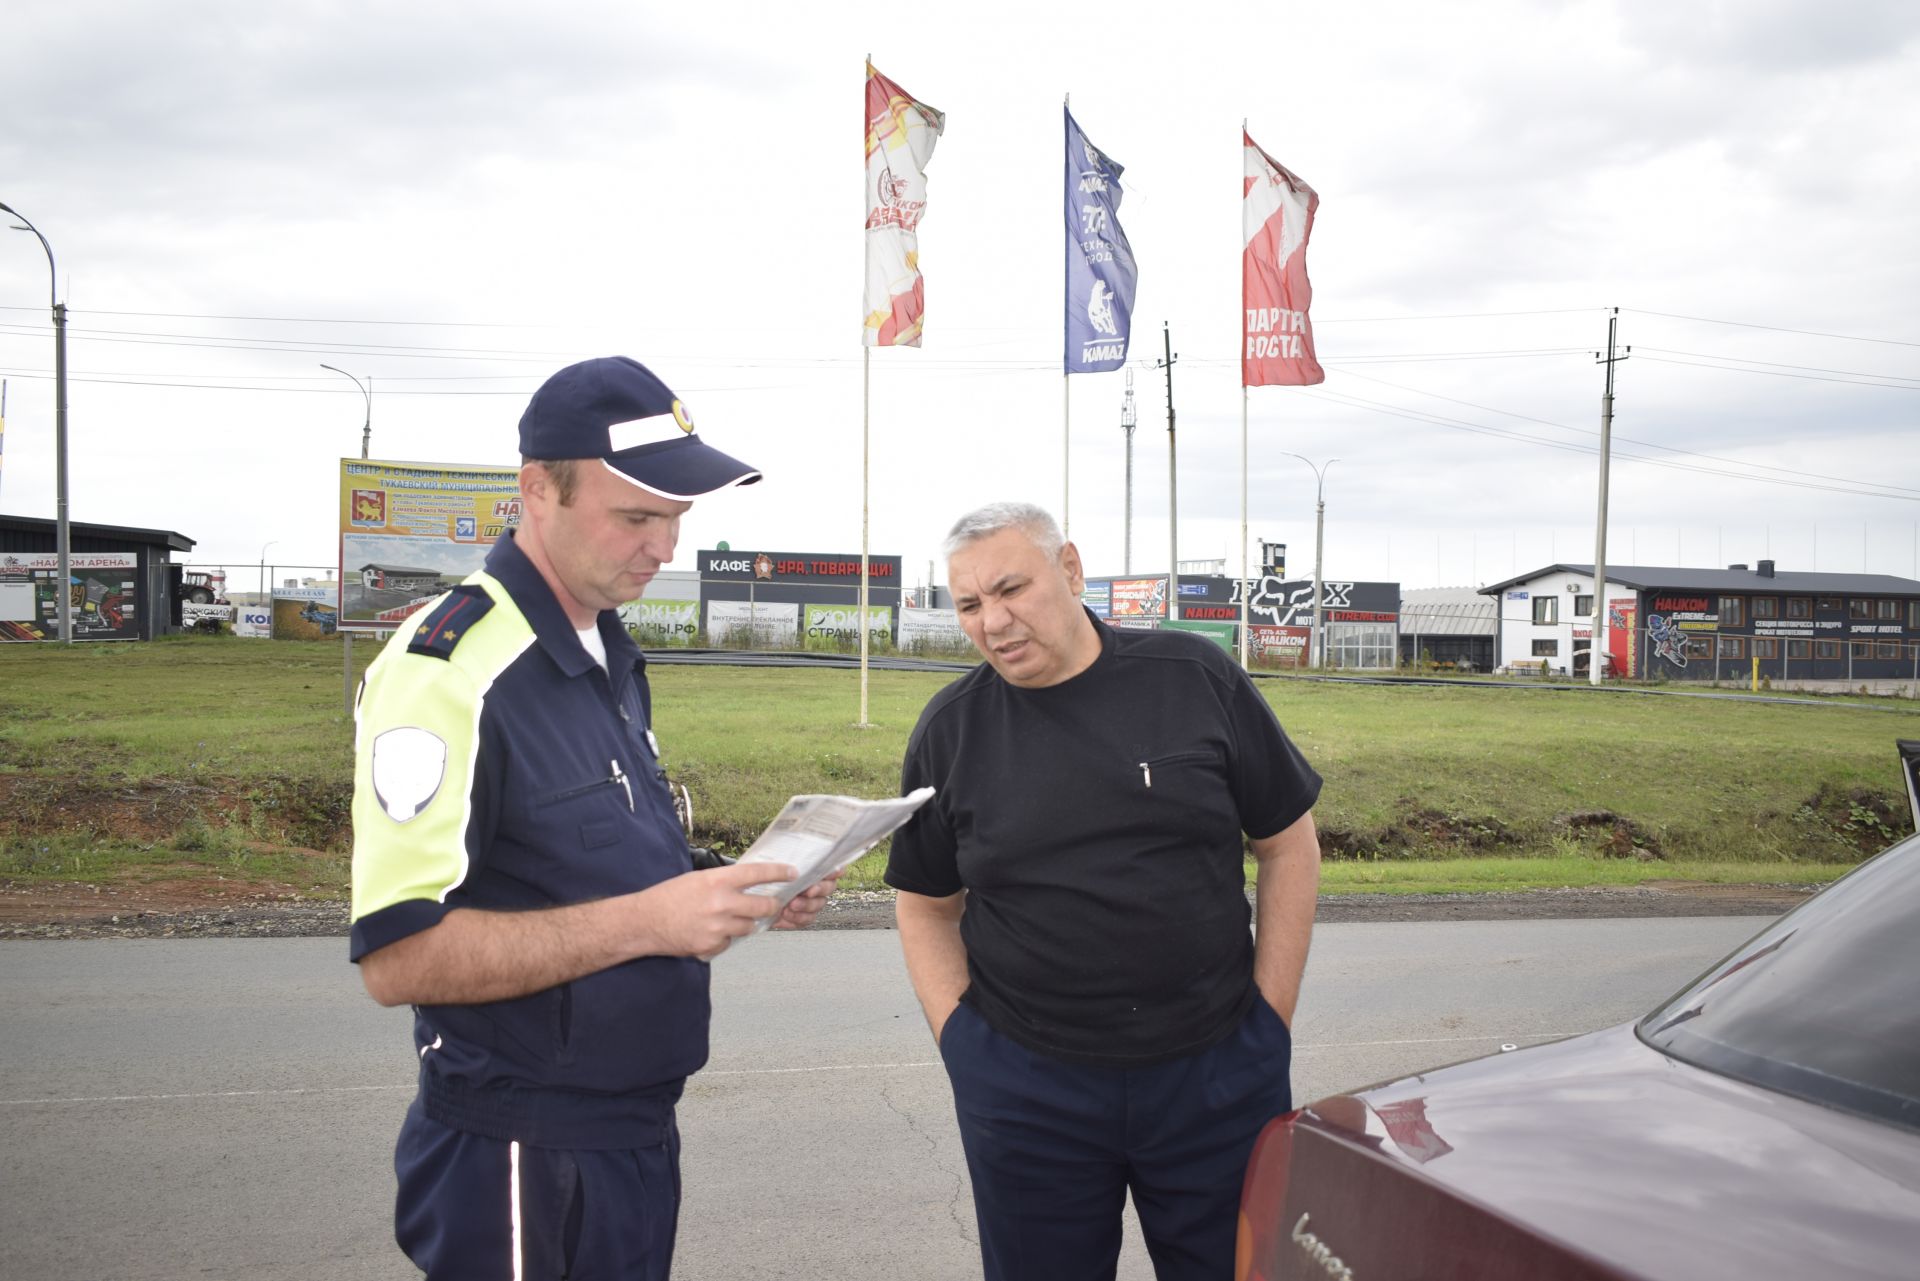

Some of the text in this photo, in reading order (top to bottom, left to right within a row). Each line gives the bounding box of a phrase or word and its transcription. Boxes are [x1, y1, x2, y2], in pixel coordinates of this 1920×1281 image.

[1080, 240, 1113, 252] ЕХНО
[1246, 335, 1303, 360] РОСТА
[347, 464, 381, 475] ЦЕНТР
[394, 467, 442, 479] СТАДИОН
[447, 471, 518, 482] ТЕХНИЧЕСКИХ
[380, 479, 438, 490] ТУКАЕВСКИЙ
[495, 502, 520, 515] НА
[710, 560, 750, 572] КАФЕ
[777, 561, 808, 575] УРА,
[183, 607, 230, 617] БУЖСКИЙ
[1185, 608, 1236, 620] NAIKOM
